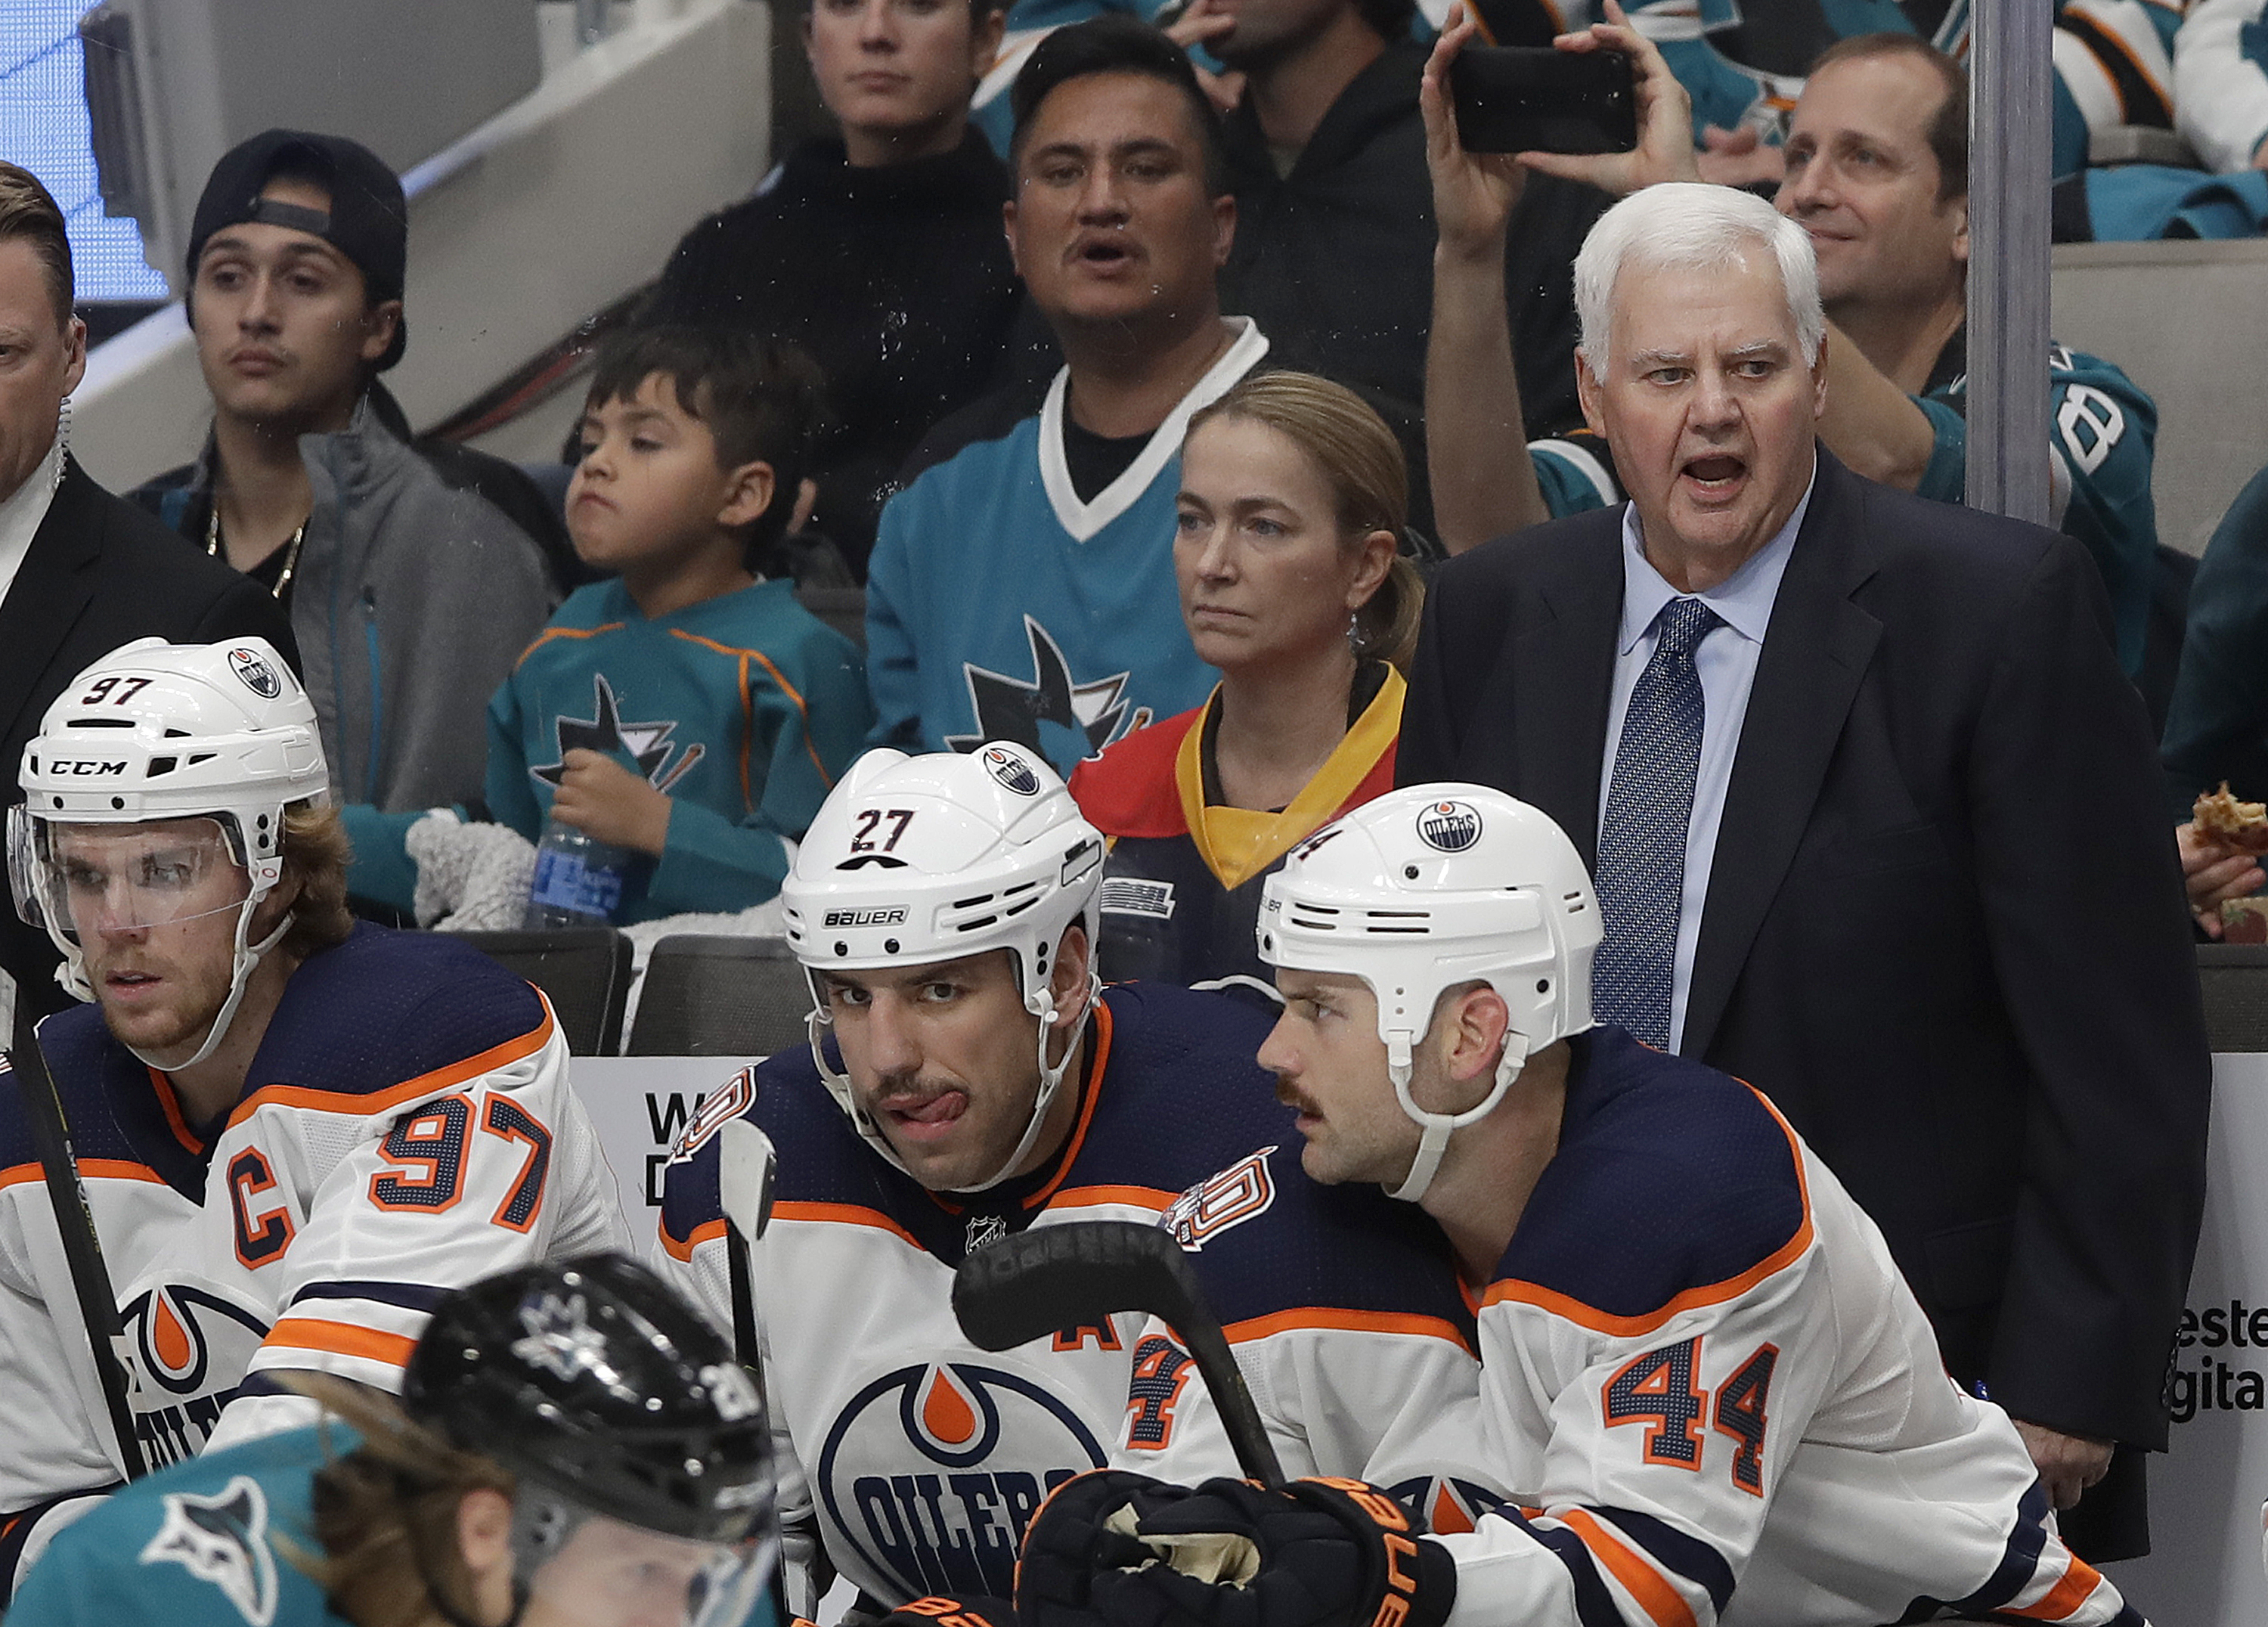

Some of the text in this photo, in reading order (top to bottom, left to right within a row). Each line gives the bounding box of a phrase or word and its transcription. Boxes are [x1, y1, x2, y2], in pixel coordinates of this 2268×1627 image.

[82, 677, 154, 705] 97
[50, 761, 128, 776] CCM
[850, 809, 916, 853] 27
[1424, 814, 1476, 848] OILERS
[824, 910, 904, 926] BAUER
[367, 1092, 553, 1234] 97
[226, 1145, 295, 1271] C
[2180, 1300, 2268, 1347] este
[2170, 1355, 2265, 1423] gita
[1600, 1334, 1780, 1498] 44
